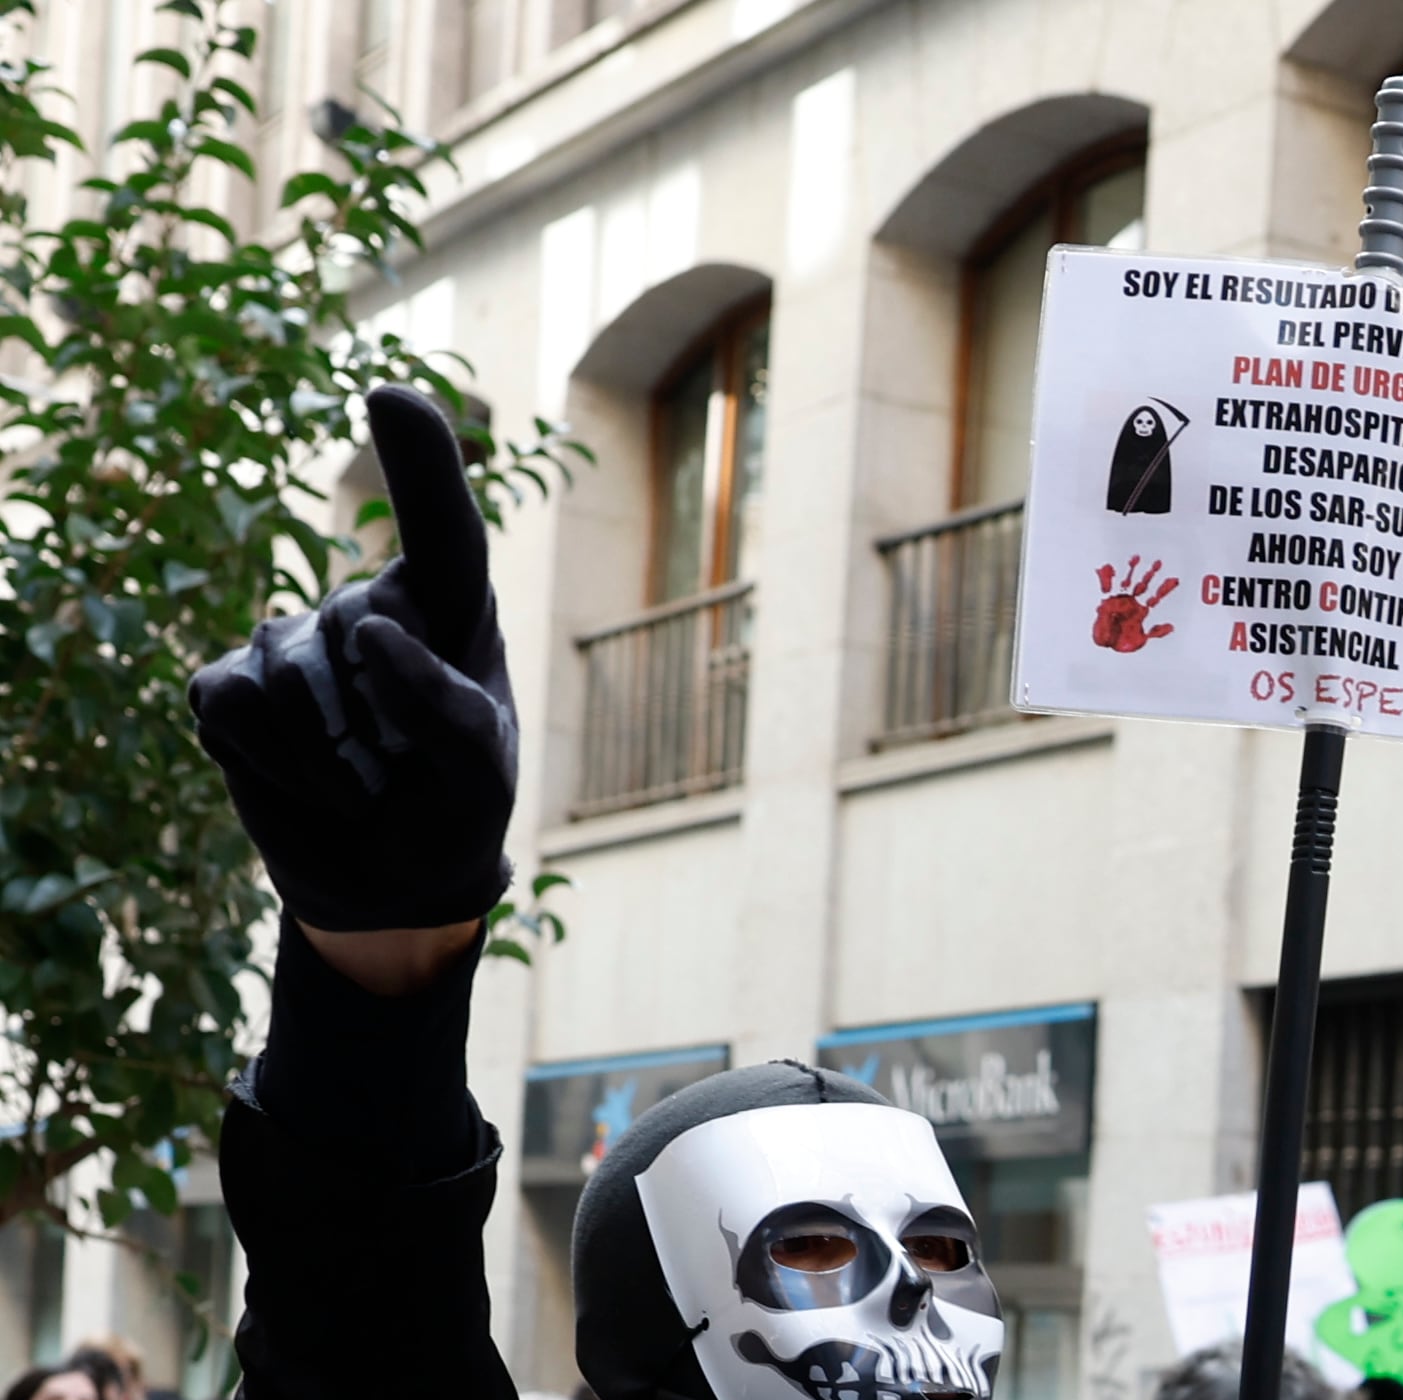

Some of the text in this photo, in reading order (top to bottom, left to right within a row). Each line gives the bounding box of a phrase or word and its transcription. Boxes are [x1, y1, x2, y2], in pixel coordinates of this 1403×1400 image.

[1123, 270, 1179, 298] SOY
[1184, 273, 1212, 300] EL
[1220, 275, 1377, 309] RESULTADO
[1277, 320, 1325, 347] DEL
[1232, 356, 1303, 388] PLAN
[1311, 361, 1345, 392] DE
[1208, 485, 1243, 516] DE
[1251, 487, 1302, 520] LOS
[1248, 532, 1344, 568] AHORA
[1352, 542, 1402, 581] SOY
[1201, 574, 1311, 610] CENTRO
[1229, 622, 1399, 670] ASISTENCIAL
[1250, 670, 1296, 703] OS
